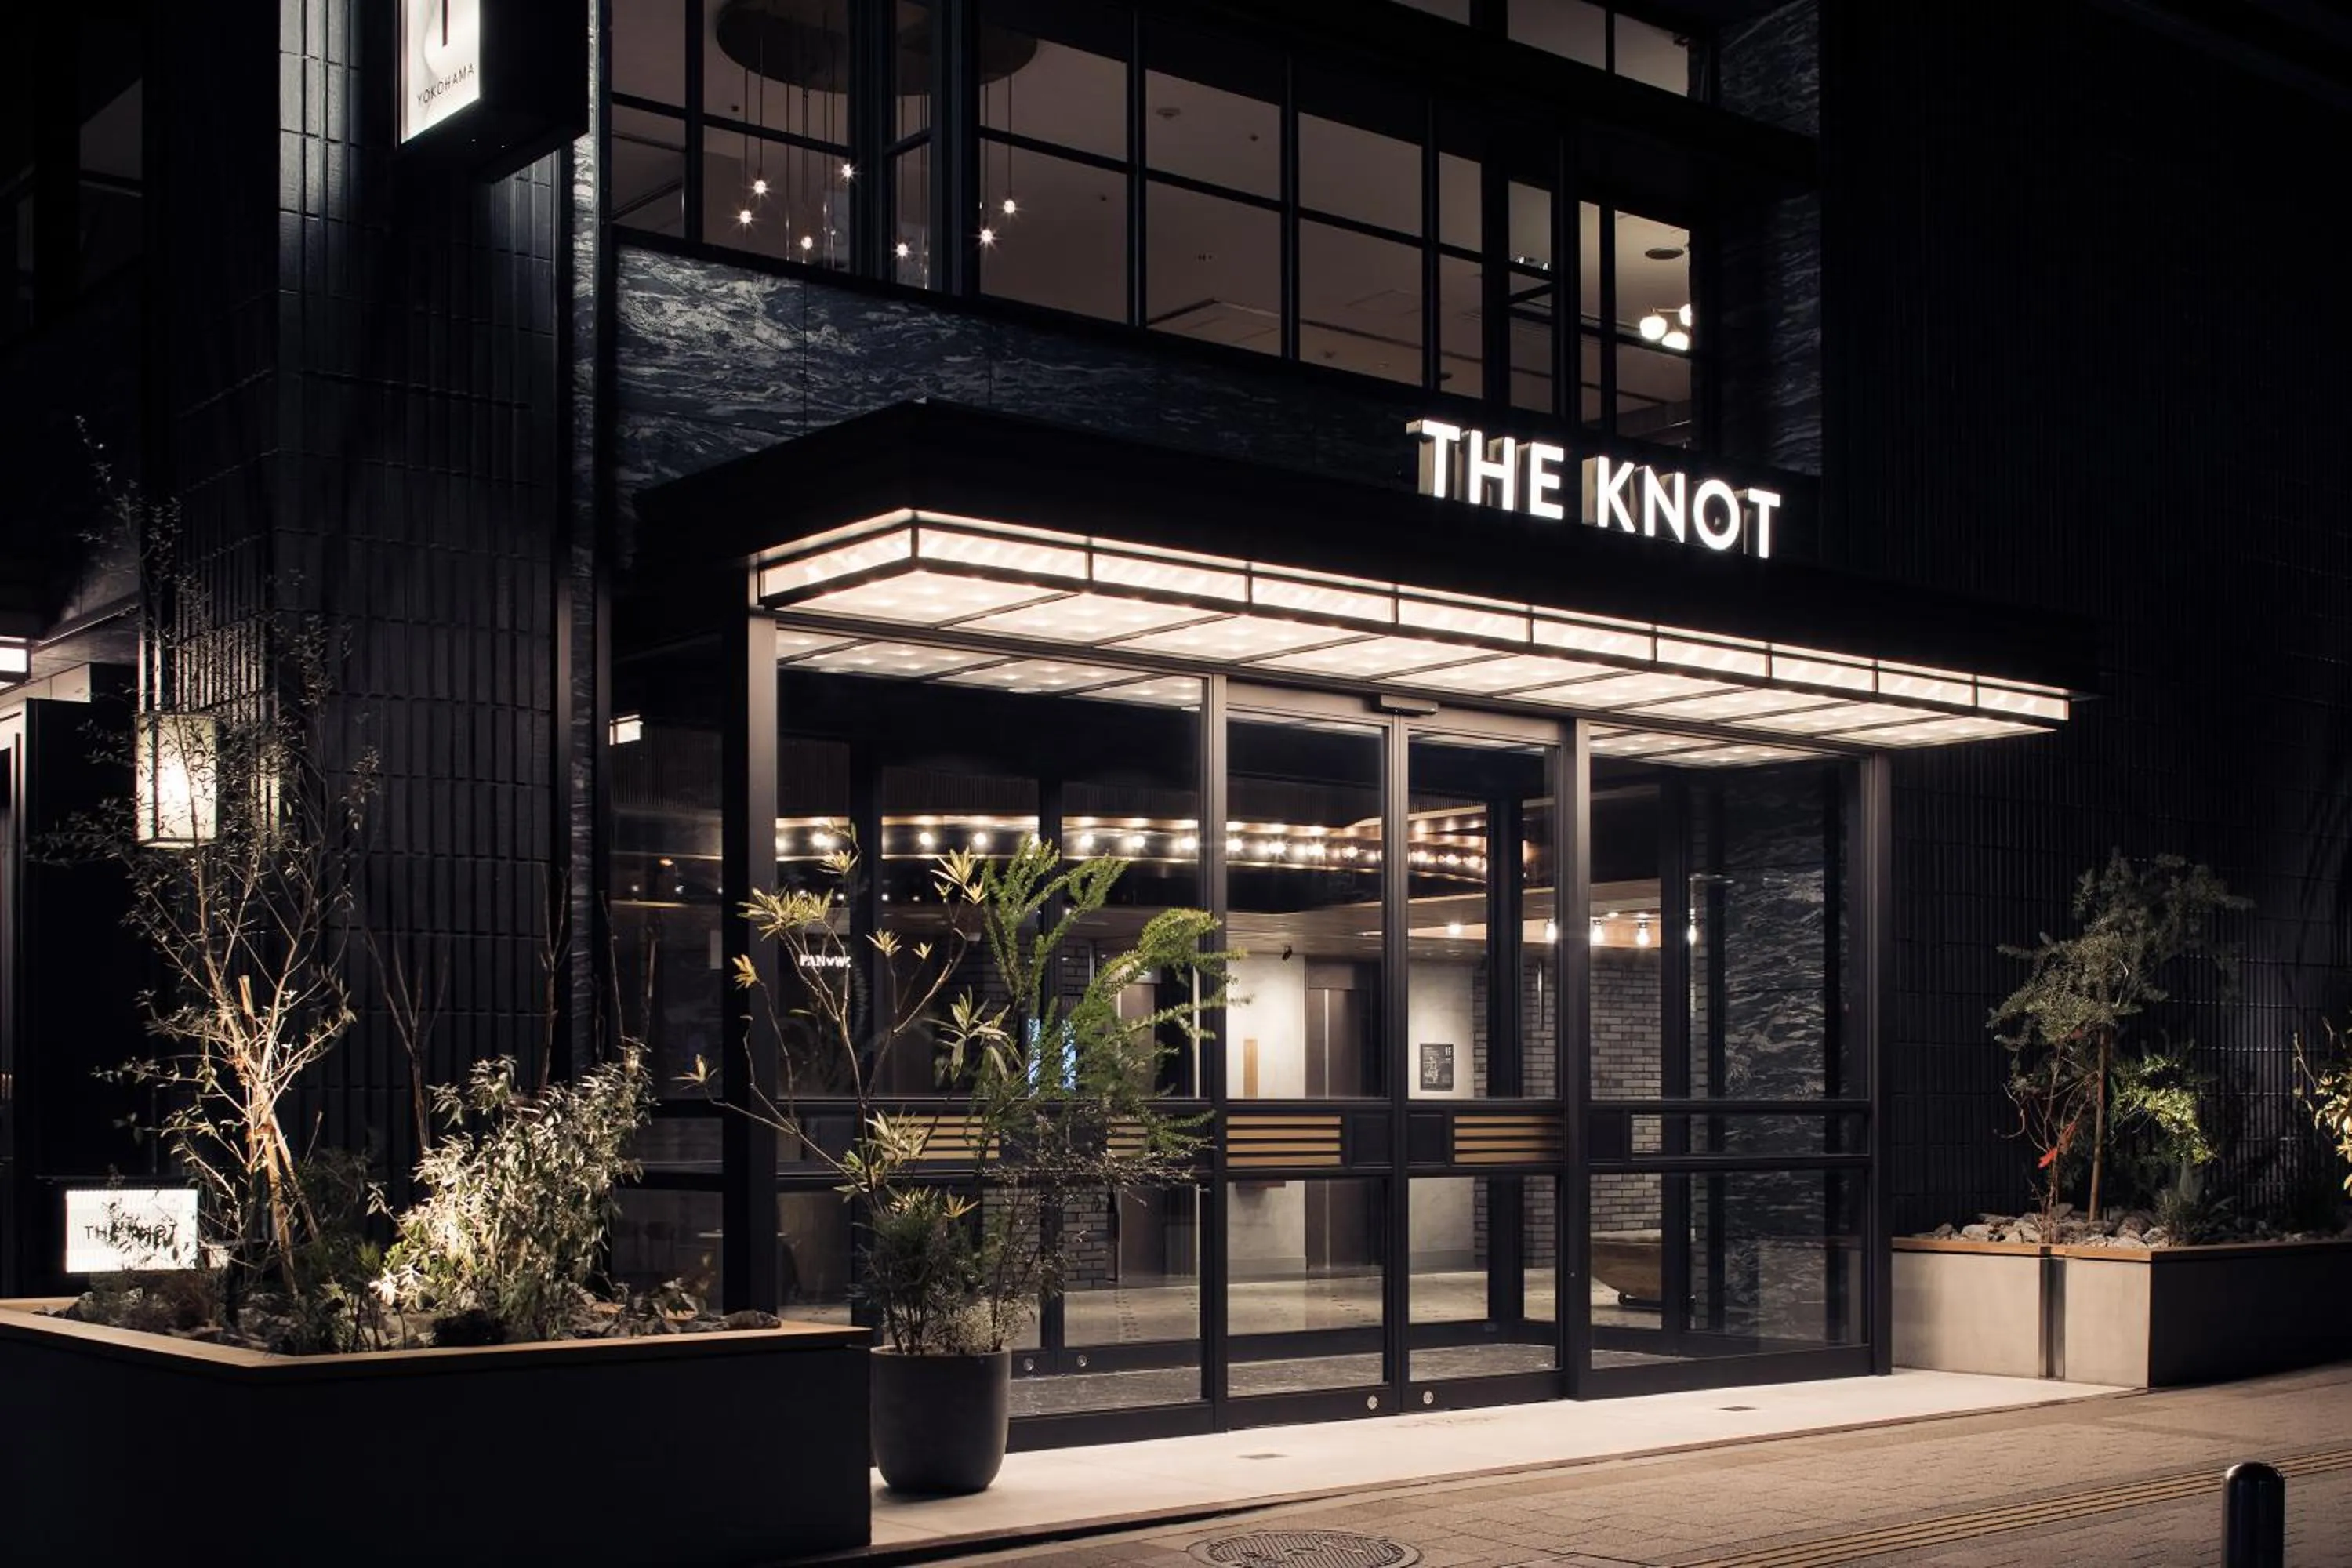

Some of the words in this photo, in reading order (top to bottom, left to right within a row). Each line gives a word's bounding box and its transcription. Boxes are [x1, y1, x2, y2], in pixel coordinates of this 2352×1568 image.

[416, 62, 474, 106] YOKOHAMA
[1406, 419, 1564, 520] THE
[1582, 455, 1781, 560] KNOT
[84, 1225, 118, 1240] TH
